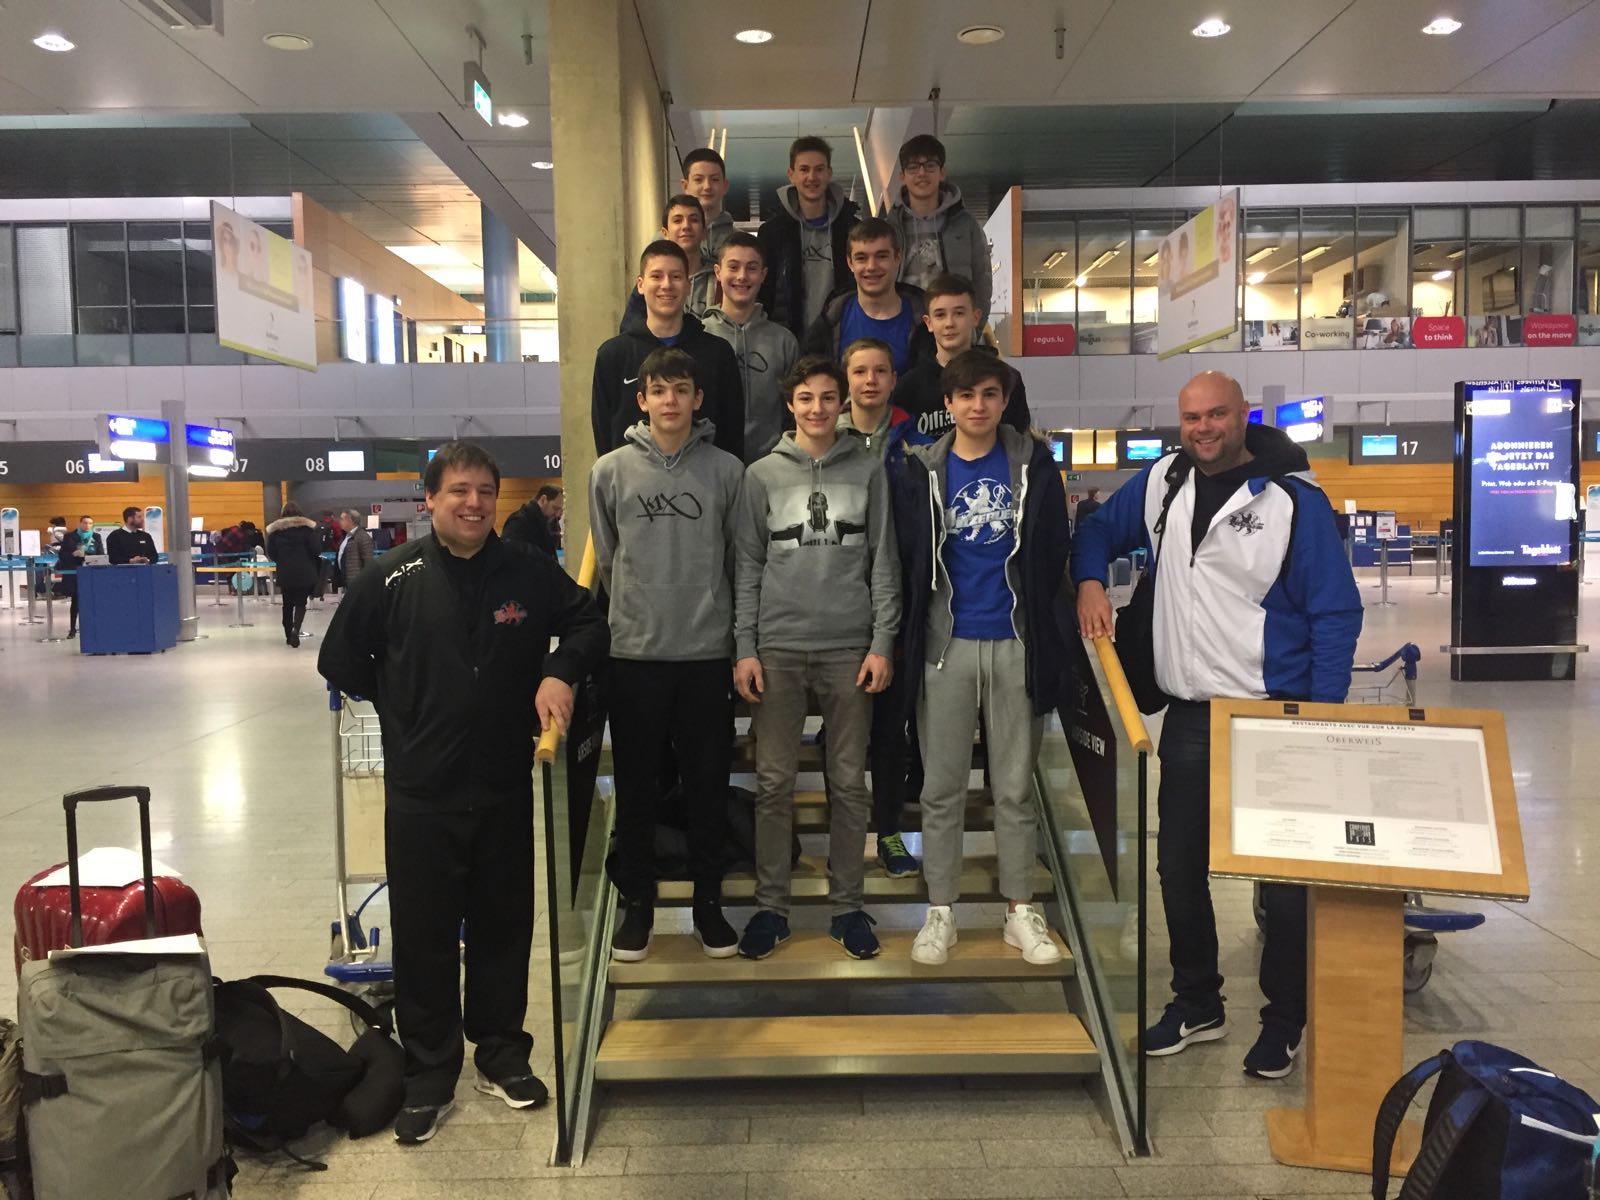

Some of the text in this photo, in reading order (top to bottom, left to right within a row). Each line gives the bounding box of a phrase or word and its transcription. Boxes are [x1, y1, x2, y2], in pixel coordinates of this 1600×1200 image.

[1033, 335, 1065, 344] regus.lu
[1304, 330, 1350, 340] Co-working
[1433, 333, 1453, 341] think
[1401, 440, 1419, 456] 17
[543, 454, 561, 469] 10
[1535, 451, 1555, 460] DAS
[65, 459, 85, 474] 06
[305, 457, 325, 472] 08
